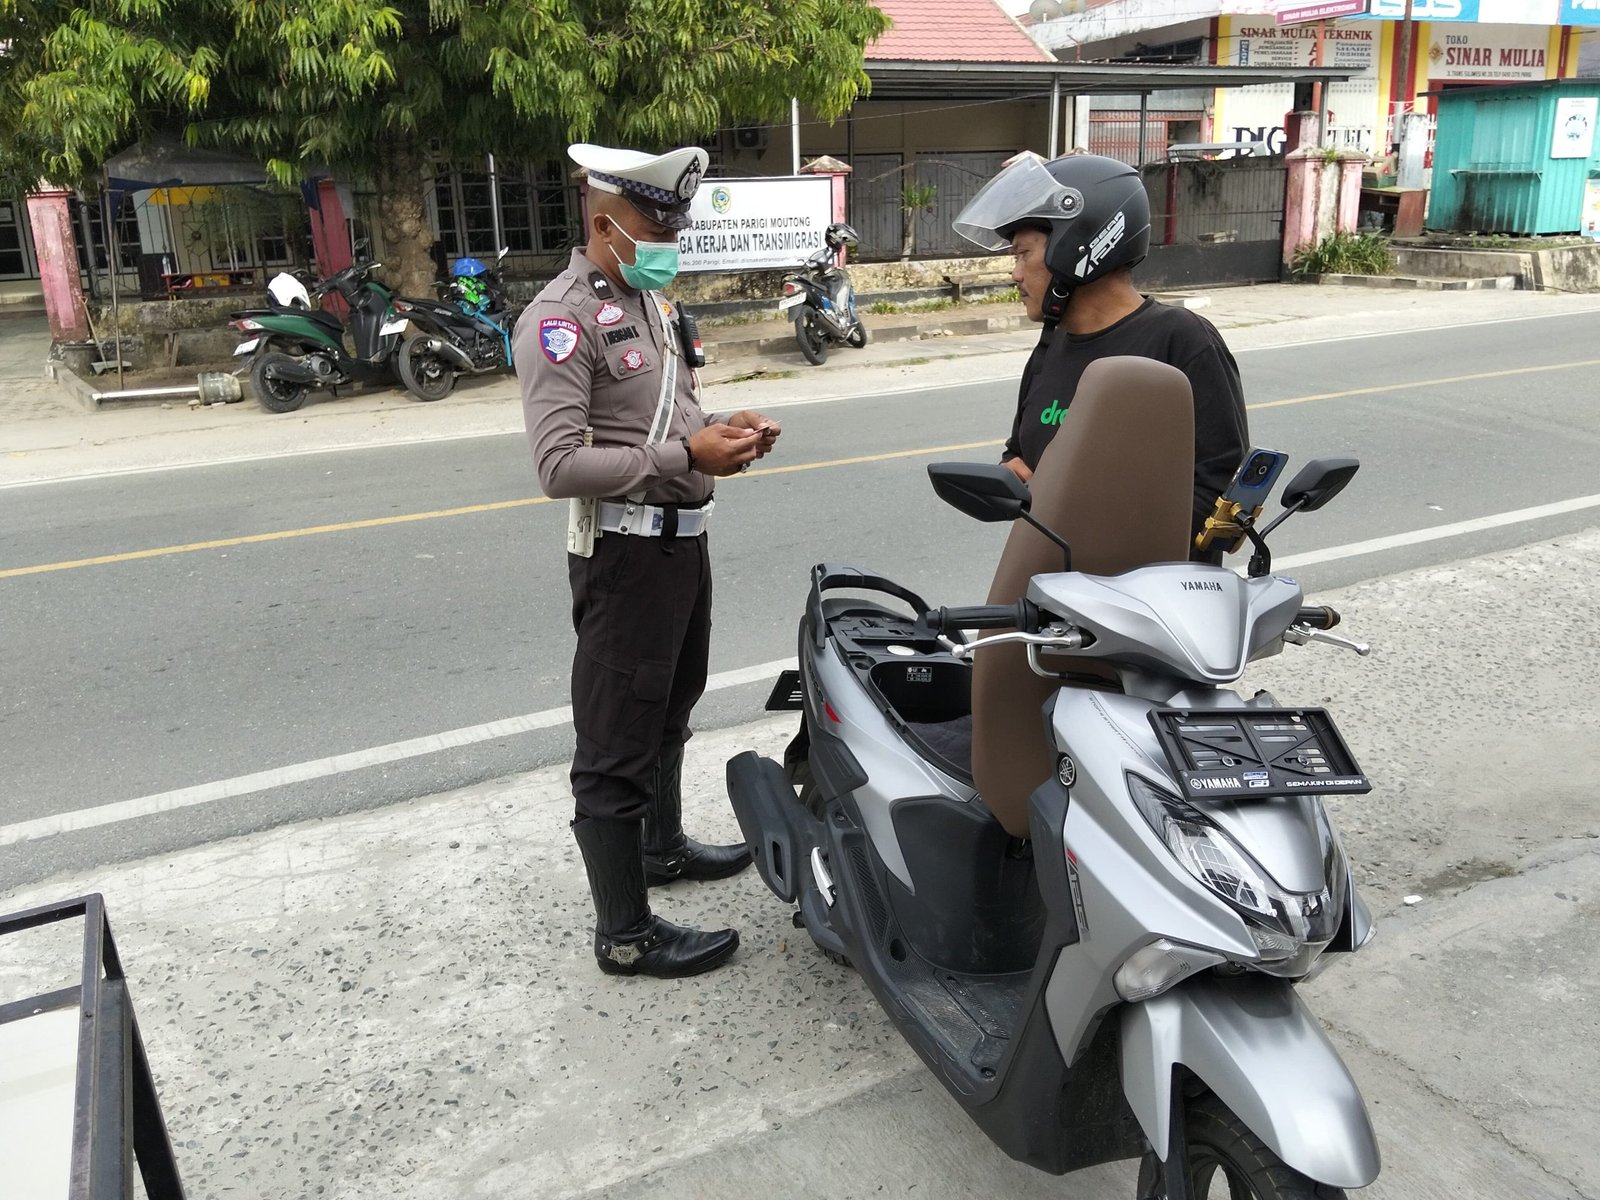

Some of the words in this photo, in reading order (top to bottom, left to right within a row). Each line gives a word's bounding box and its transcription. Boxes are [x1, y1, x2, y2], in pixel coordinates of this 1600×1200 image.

[1282, 12, 1300, 21] SINAR
[1300, 8, 1319, 18] MULIA
[1319, 3, 1357, 15] ELEKTRONIK
[1240, 27, 1277, 39] SINAR
[1281, 28, 1317, 39] MULIA
[1323, 29, 1373, 41] TEKHNIK
[1445, 35, 1468, 45] TOKO
[1445, 47, 1492, 67] SINAR
[1499, 48, 1545, 67] MULIA
[689, 219, 739, 231] KABUPATEN
[741, 218, 768, 229] PARIGI
[770, 216, 811, 228] MOUTONG
[695, 233, 728, 253] KERJA
[730, 232, 750, 252] DAN
[752, 231, 822, 250] TRANSMIGRASI
[542, 319, 557, 328] LALU
[558, 320, 578, 332] LINTAS
[1180, 581, 1223, 592] YAMAHA
[1200, 777, 1242, 790] YAMAHA
[1286, 780, 1325, 788] SEMAKIN
